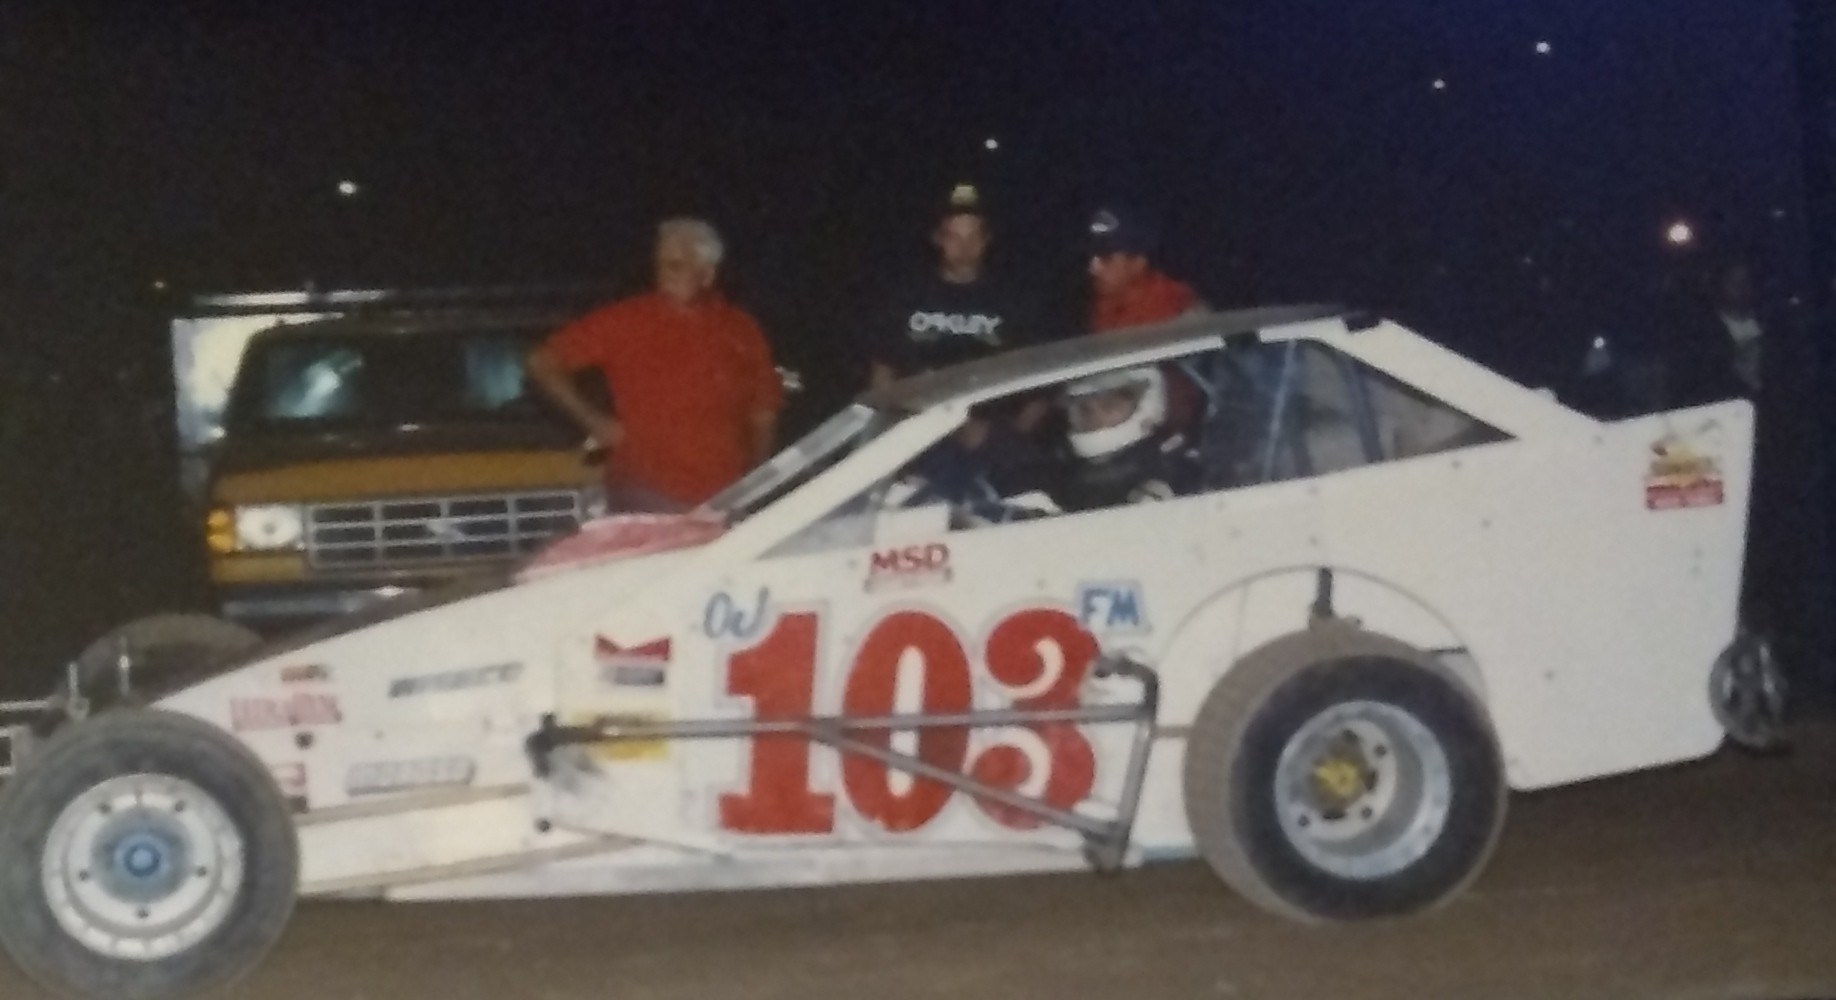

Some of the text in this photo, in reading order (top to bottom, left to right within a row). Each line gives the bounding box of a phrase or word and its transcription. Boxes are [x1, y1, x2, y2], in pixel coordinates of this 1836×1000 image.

[870, 543, 951, 575] MSD
[1082, 588, 1140, 626] FM
[719, 609, 1099, 834] 103
